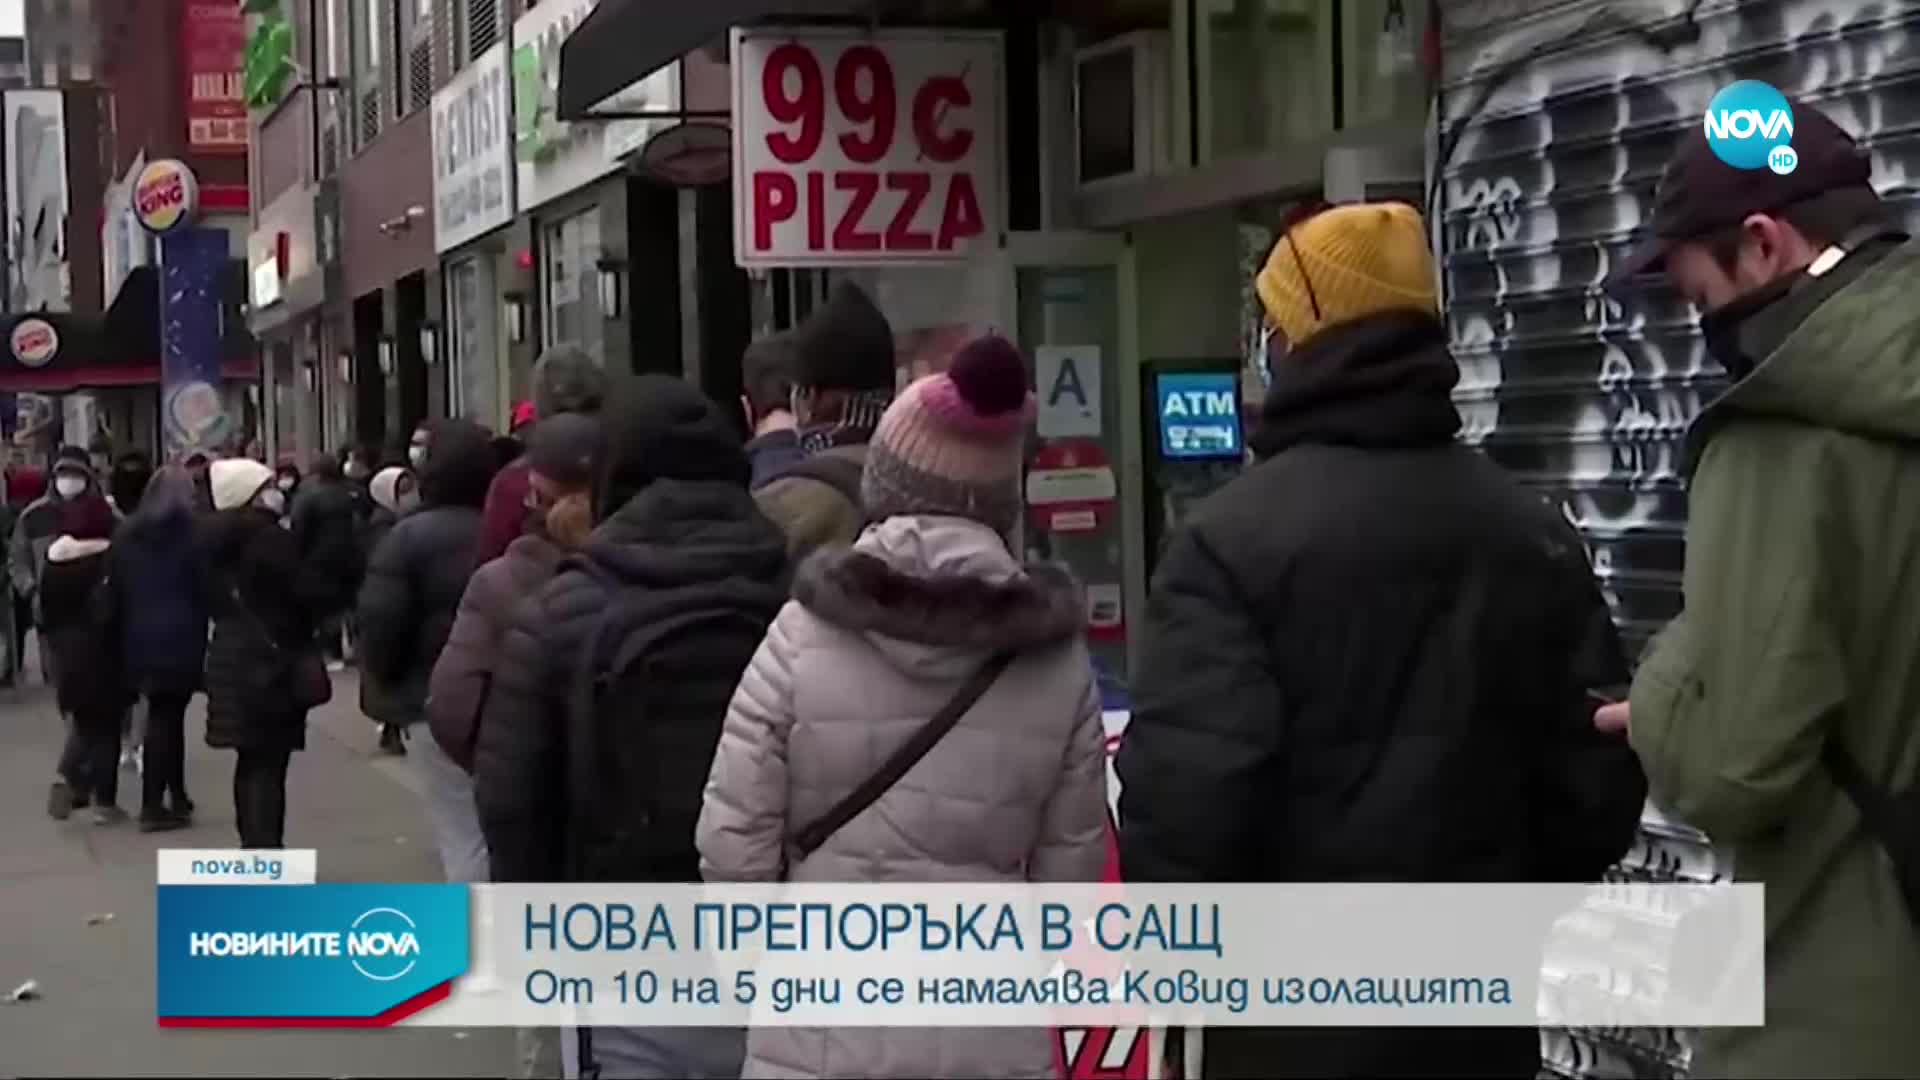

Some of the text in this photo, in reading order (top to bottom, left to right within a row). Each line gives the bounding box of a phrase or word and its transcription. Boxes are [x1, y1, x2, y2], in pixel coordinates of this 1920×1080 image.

[753, 171, 985, 252] PIZZA
[1048, 358, 1087, 407] A
[1164, 391, 1234, 416] ATM
